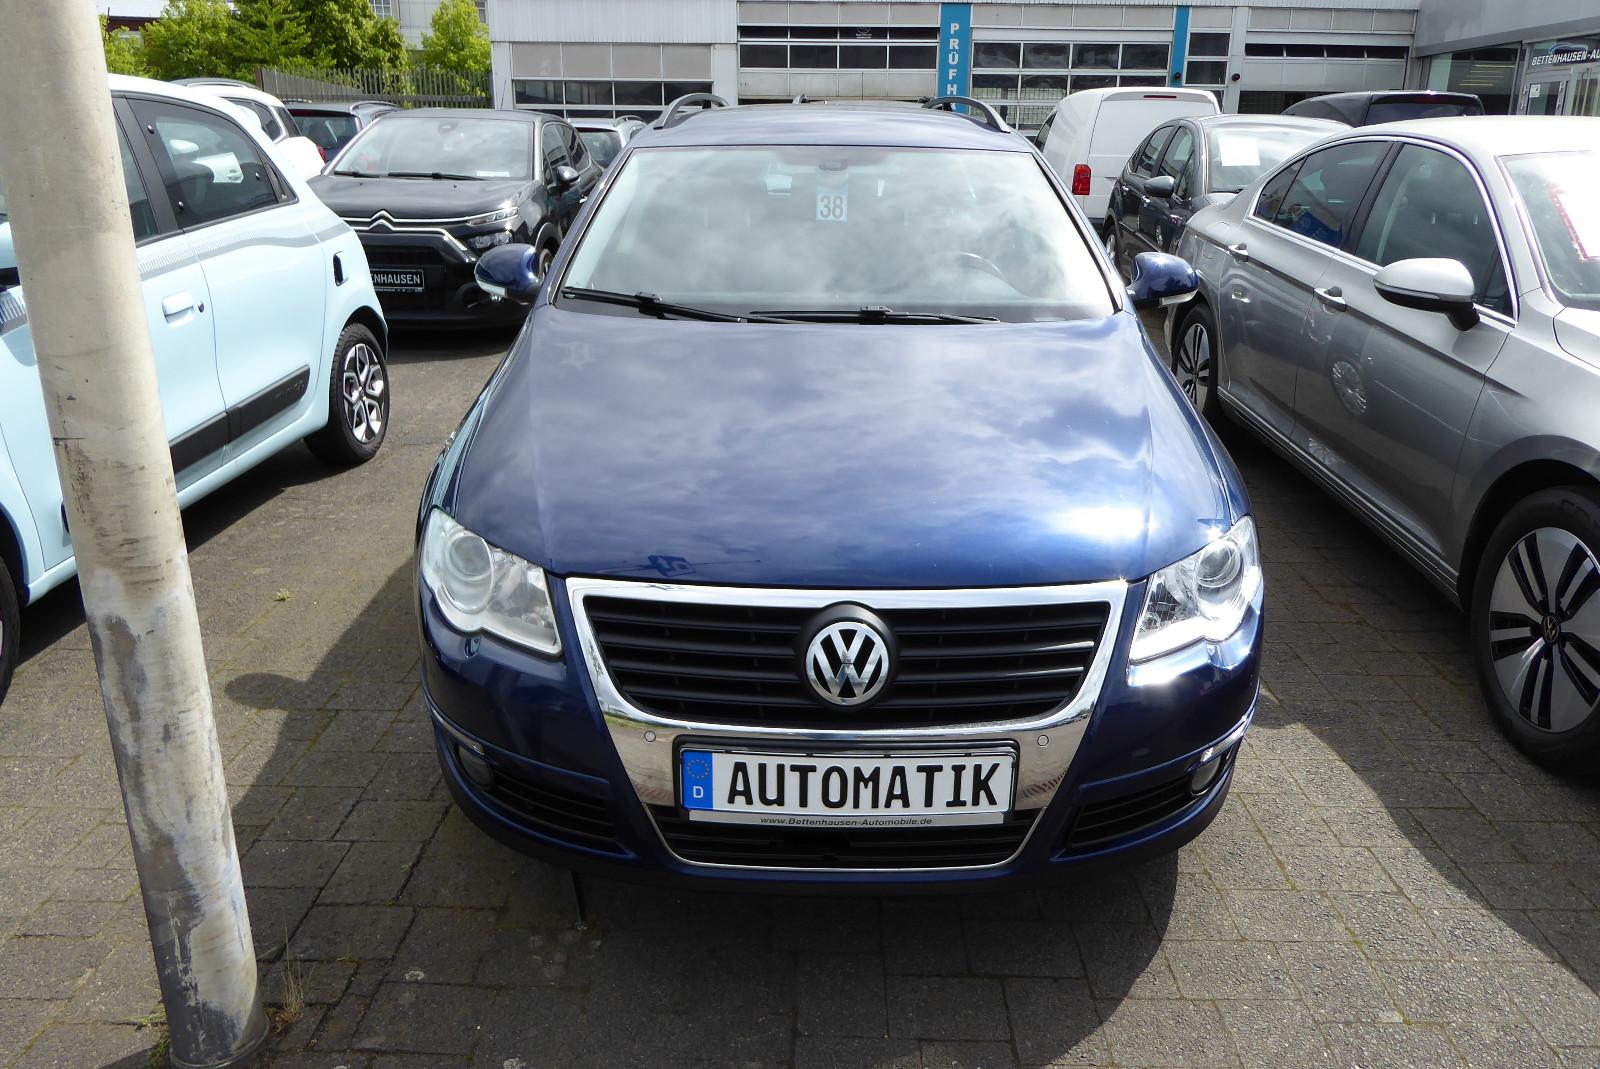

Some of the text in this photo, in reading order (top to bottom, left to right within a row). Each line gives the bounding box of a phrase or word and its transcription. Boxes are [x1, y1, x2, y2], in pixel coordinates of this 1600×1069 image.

[820, 195, 844, 219] 38
[371, 273, 420, 284] NHAUSEN
[692, 785, 704, 798] D
[727, 761, 1000, 809] AUTOMATIK
[760, 817, 932, 827] www.Bettenhausen-Automobile.de
